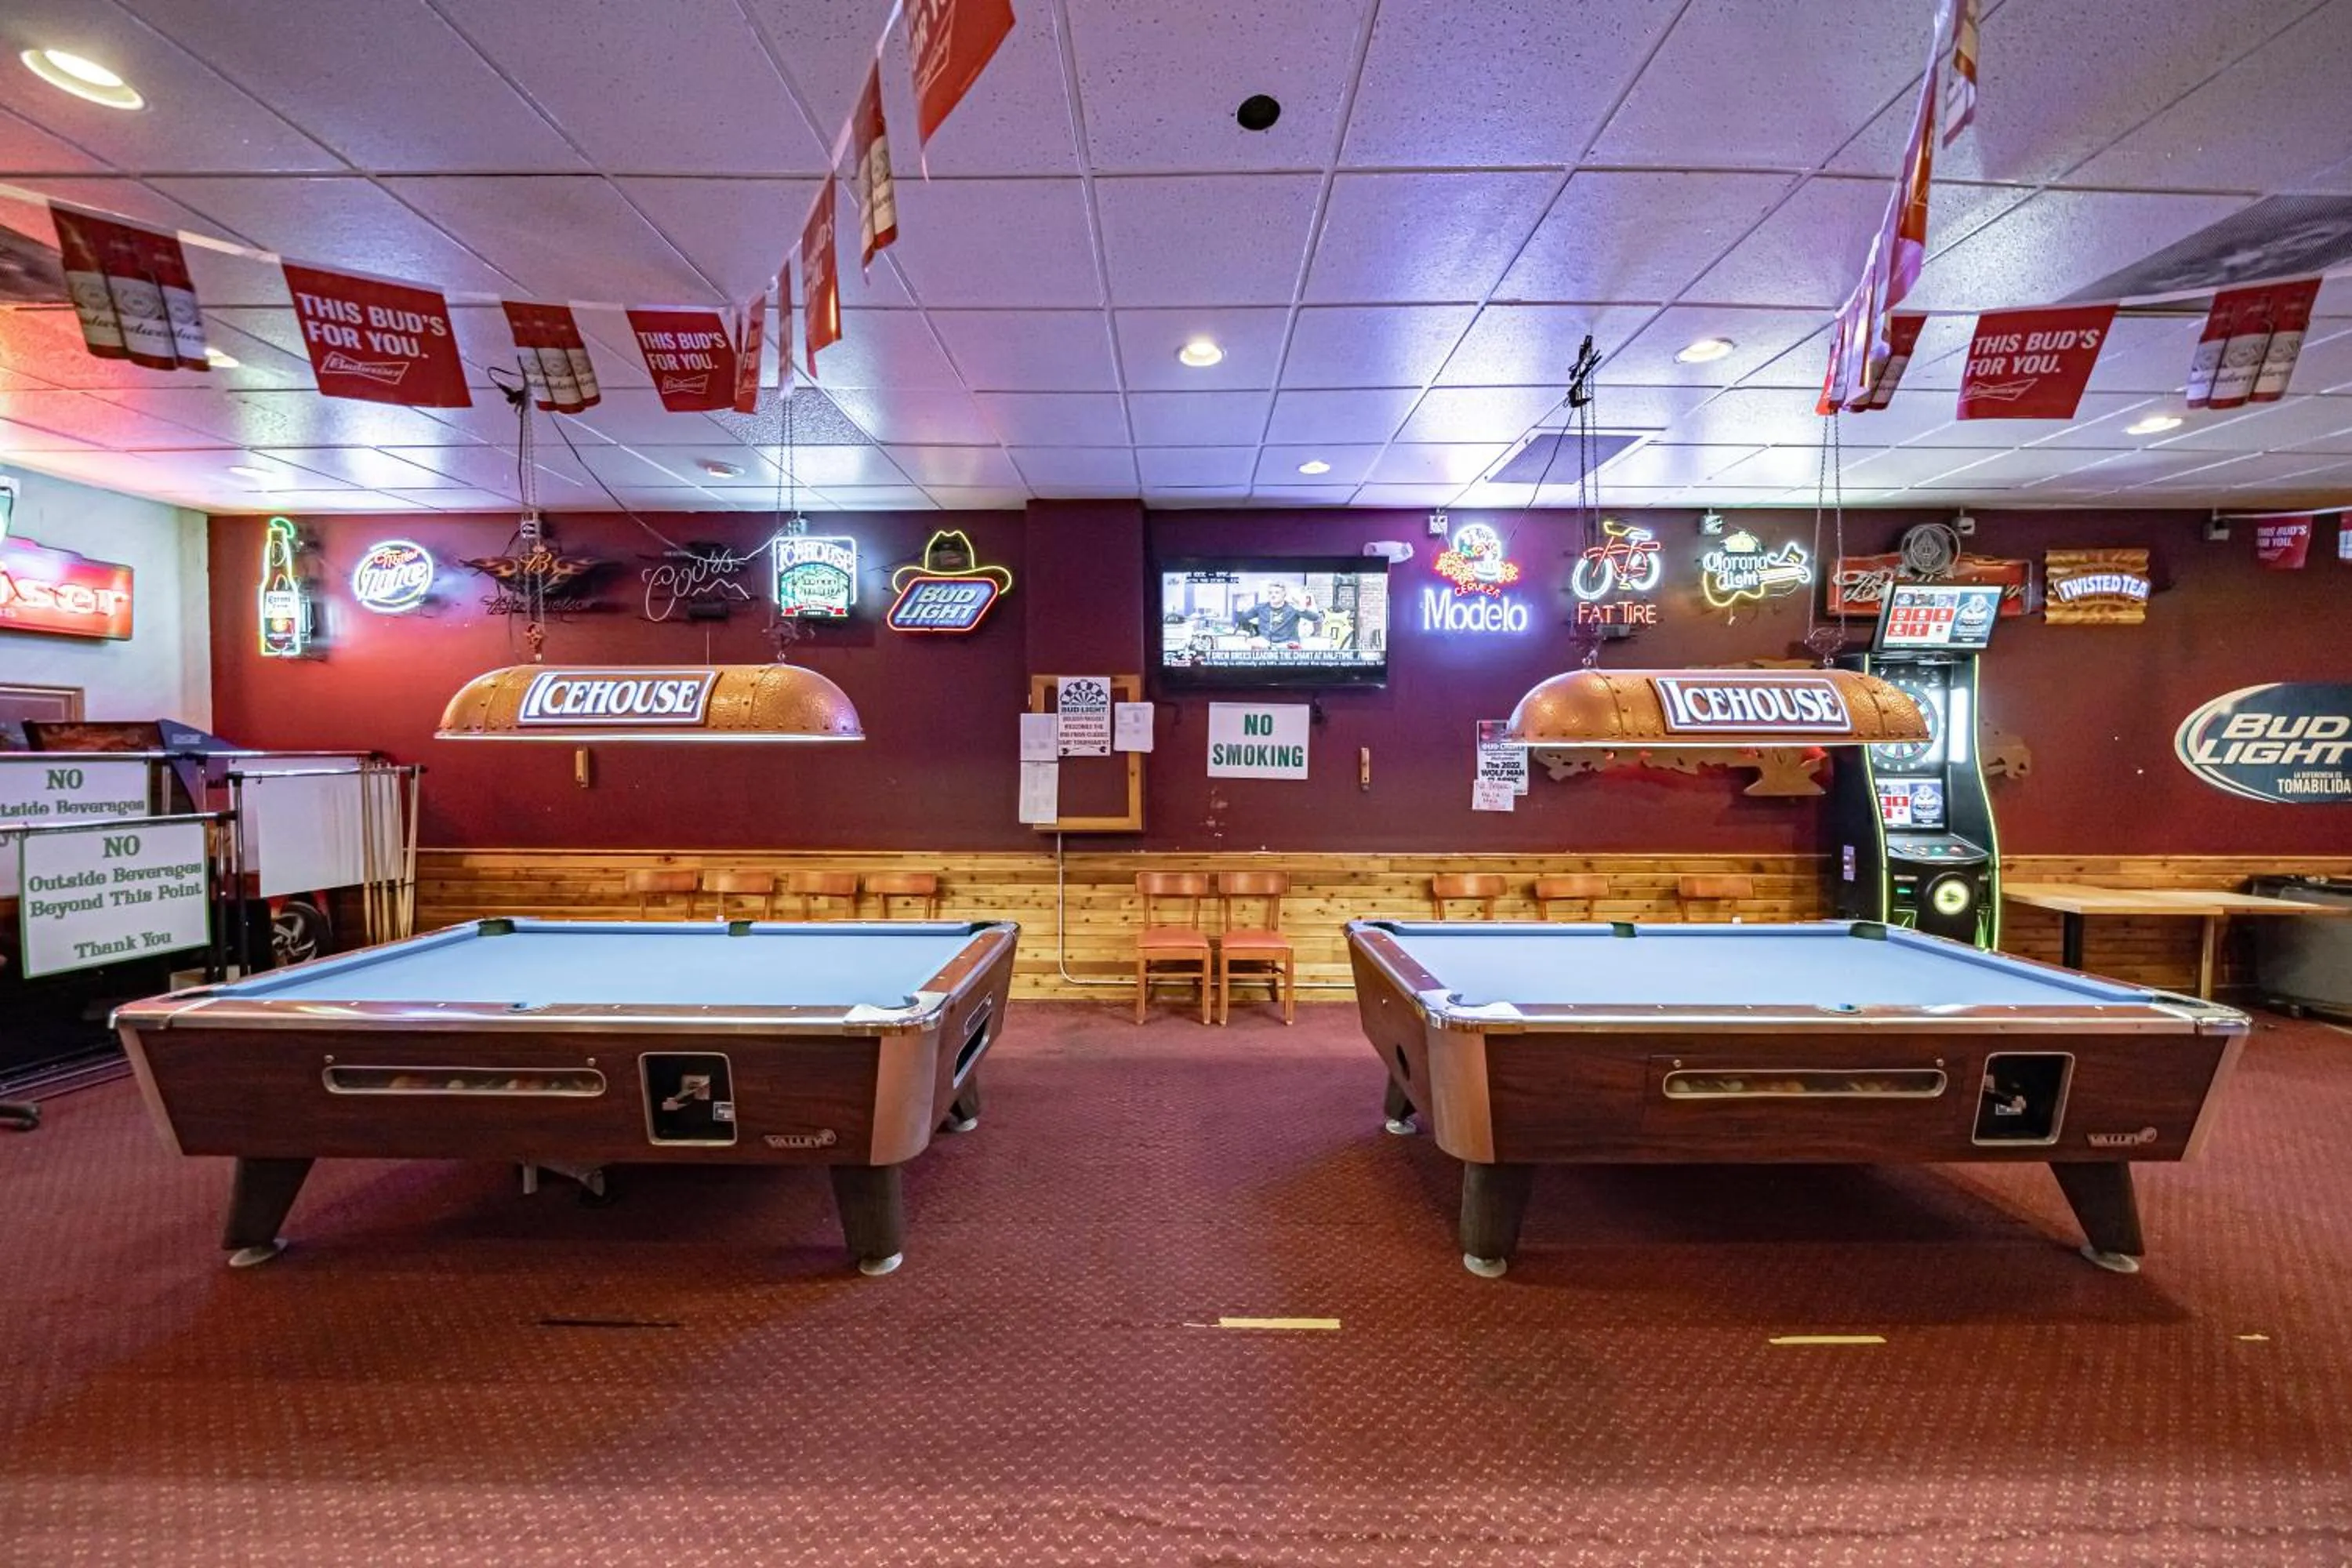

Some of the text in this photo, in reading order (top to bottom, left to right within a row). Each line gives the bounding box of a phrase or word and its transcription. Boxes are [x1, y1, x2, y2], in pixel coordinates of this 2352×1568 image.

[297, 292, 447, 336] THIS BUD'S
[306, 320, 429, 359] FOR YOU.
[637, 332, 726, 350] THIS BUD'S
[1975, 328, 2100, 355] THIS BUD'S
[646, 353, 719, 371] FOR YOU.
[1966, 354, 2061, 377] FOR YOU.
[1702, 551, 1768, 572] Corona
[917, 587, 978, 604] BUD
[1455, 583, 1501, 599] CERVEZA
[2060, 575, 2148, 599] TWISTED TEA
[898, 603, 977, 620] LIGHT
[1423, 589, 1528, 631] Modelo
[1578, 601, 1657, 624] FAT TIRE
[526, 674, 702, 716] ICEHOUSE
[1664, 680, 1844, 724] ICEHOUSE
[1243, 714, 1273, 736] NO
[2222, 713, 2350, 739] BUD
[1212, 743, 1304, 767] SMOKING
[2192, 739, 2352, 764] LIGHT
[45, 769, 84, 790] NO
[56, 799, 145, 816] Beverages
[103, 835, 141, 858] NO
[28, 862, 202, 892] Outside Beverages
[29, 882, 203, 919] Beyond This Point
[74, 931, 172, 960] Thank You
